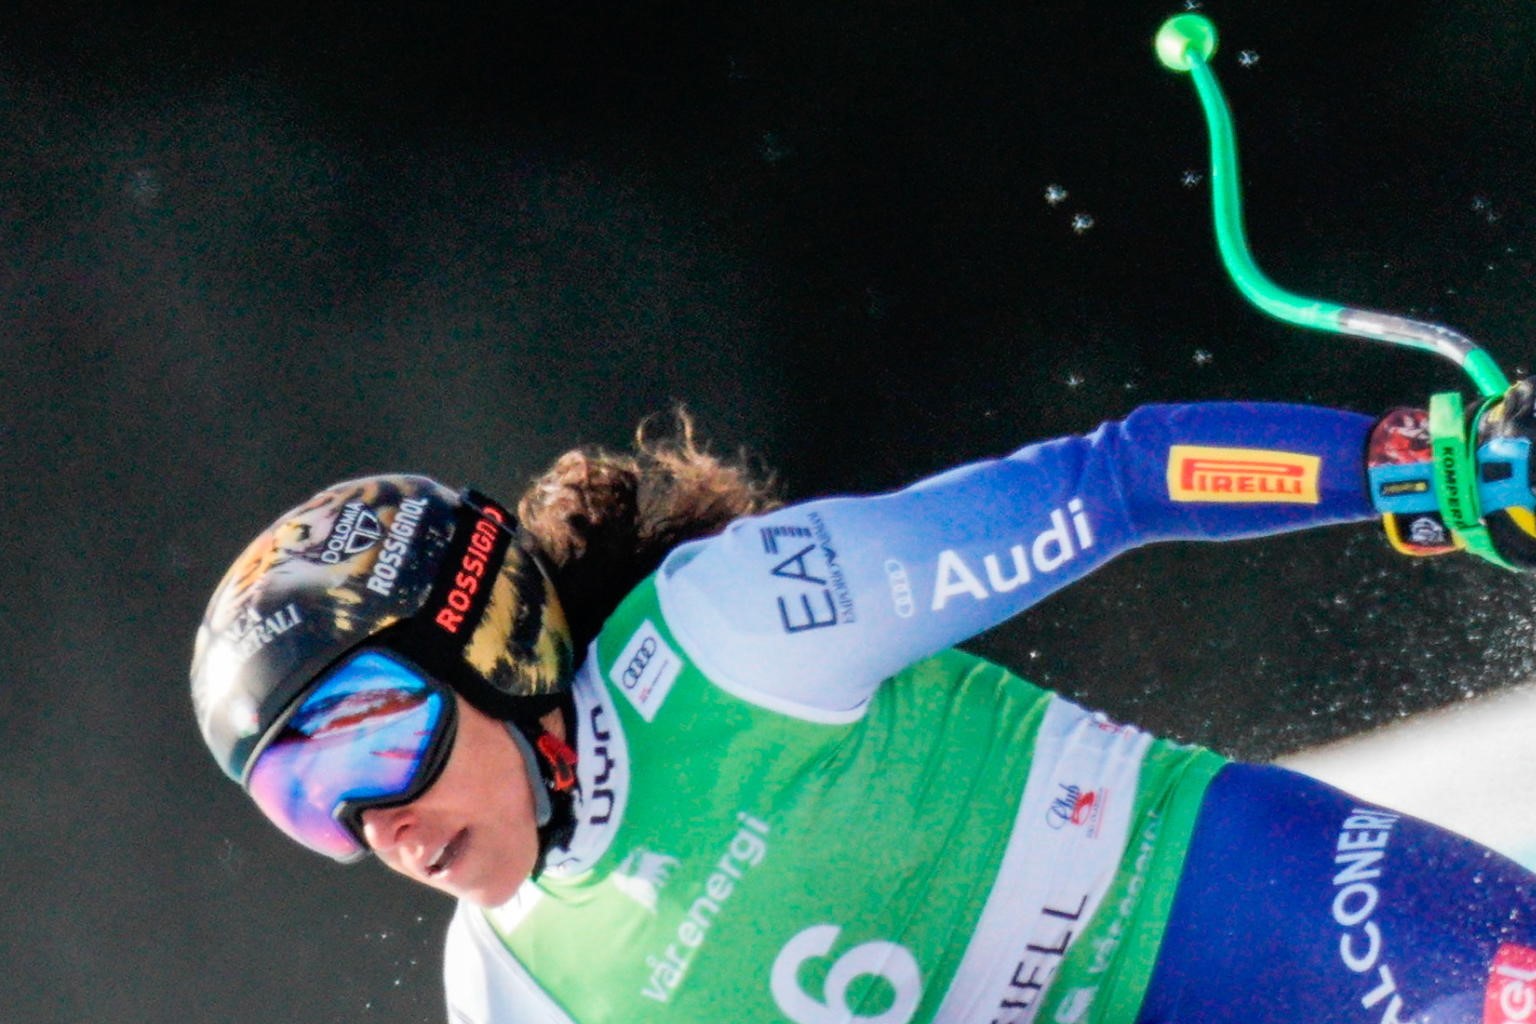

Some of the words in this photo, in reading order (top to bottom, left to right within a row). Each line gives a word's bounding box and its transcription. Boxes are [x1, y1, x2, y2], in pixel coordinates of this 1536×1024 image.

[1181, 457, 1306, 495] PIRELLI
[366, 498, 429, 597] ROSSIGNOL
[931, 498, 1094, 612] Audi
